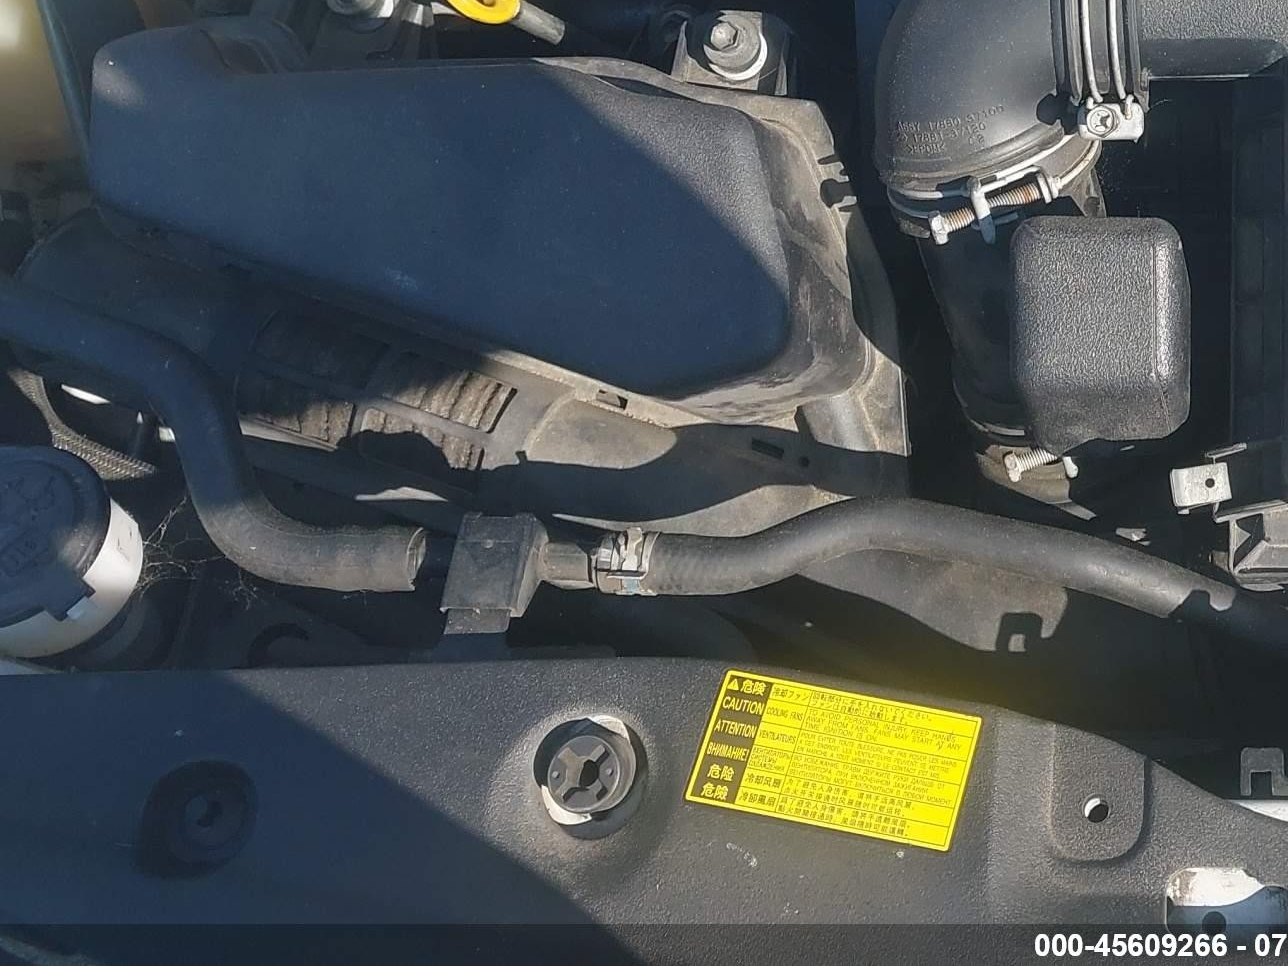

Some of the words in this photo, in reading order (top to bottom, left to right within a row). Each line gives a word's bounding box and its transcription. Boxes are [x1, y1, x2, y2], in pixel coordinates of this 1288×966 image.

[739, 678, 767, 696] 危険
[721, 695, 765, 715] CAUTION
[765, 705, 789, 719] COOLING
[788, 710, 804, 721] FANS
[713, 718, 757, 738] ATTENTION
[803, 722, 821, 731] TIME
[805, 715, 826, 725] AWAY
[827, 719, 849, 729] FROM
[910, 735, 933, 745] START
[947, 742, 961, 751] ANY
[820, 710, 841, 721] AVOID
[843, 715, 880, 728] PERSONAL
[910, 727, 930, 738] KEEP
[757, 728, 797, 744] VENTILATEURS
[706, 762, 736, 782] 危险
[699, 781, 730, 801] 危險
